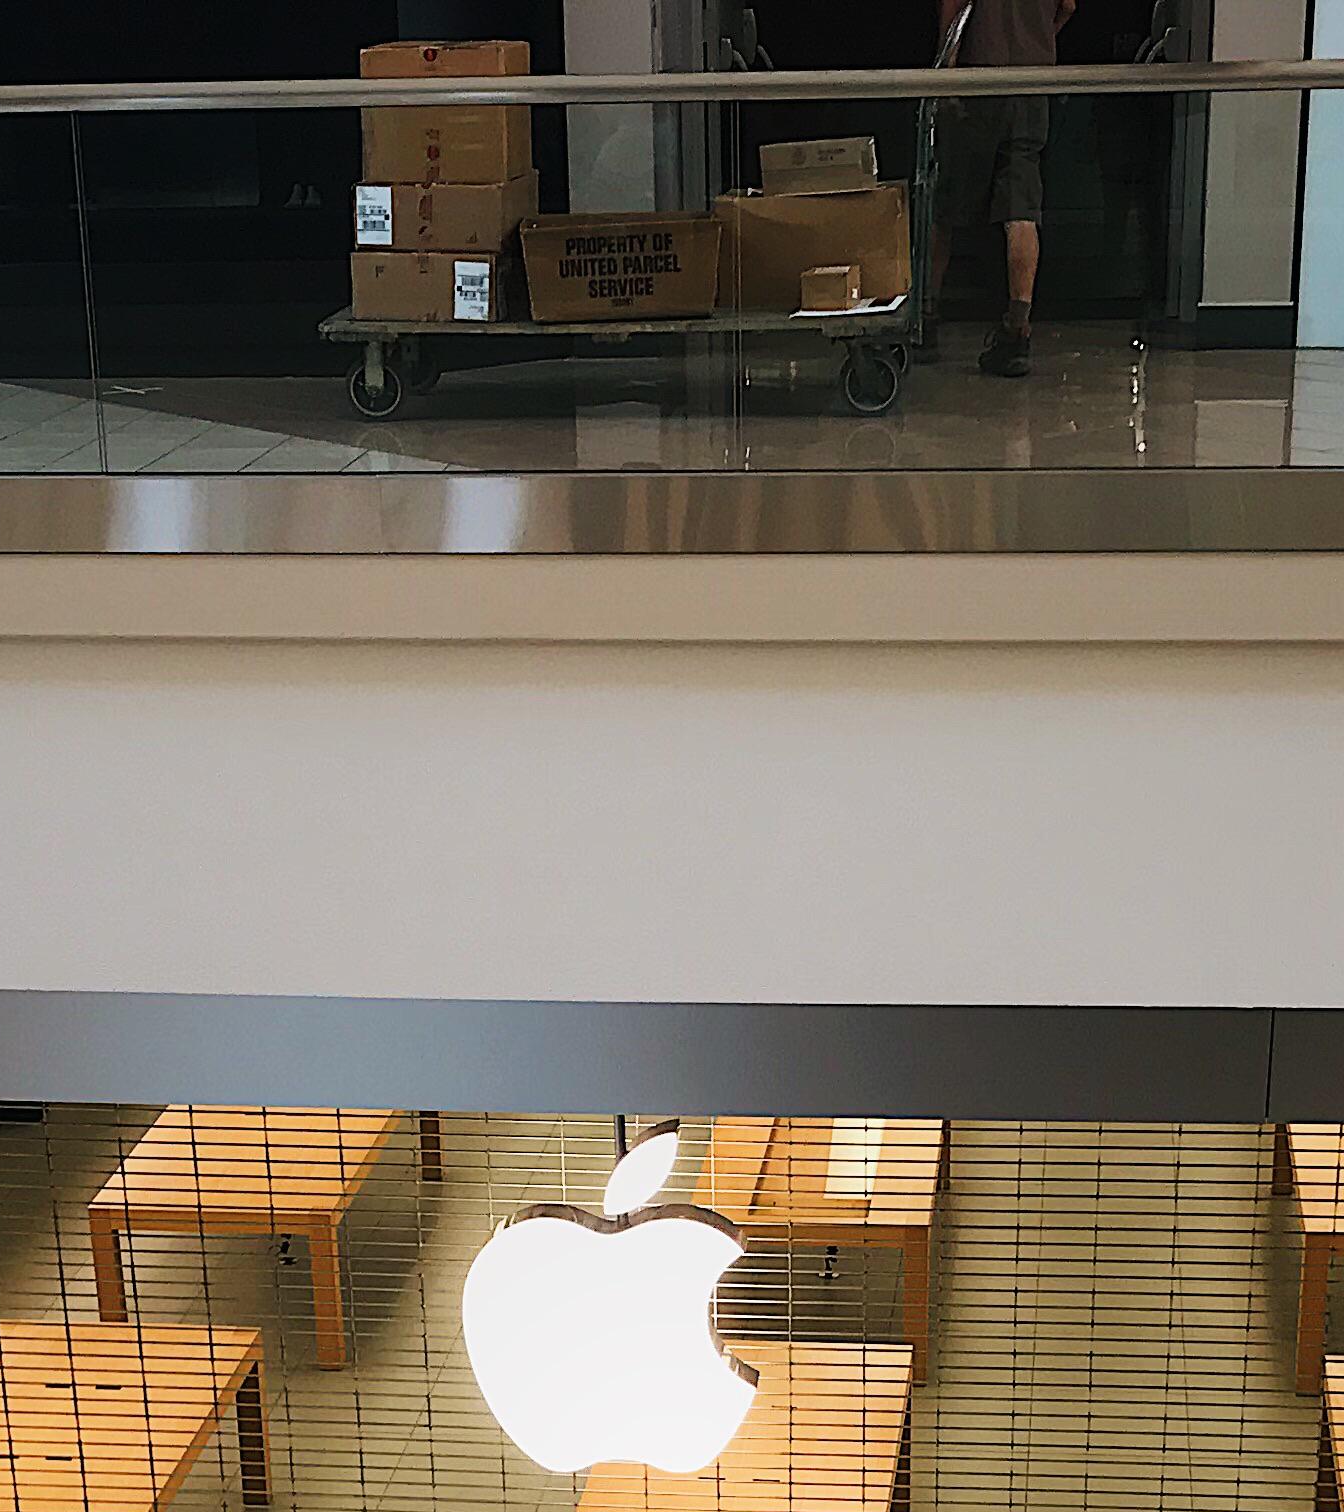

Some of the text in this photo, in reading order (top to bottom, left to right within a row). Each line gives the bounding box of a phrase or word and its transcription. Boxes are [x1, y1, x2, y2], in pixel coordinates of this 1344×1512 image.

[566, 233, 673, 256] PROPERTY OF
[559, 254, 682, 279] UNITED PARCEL
[588, 277, 654, 299] SERVICE
